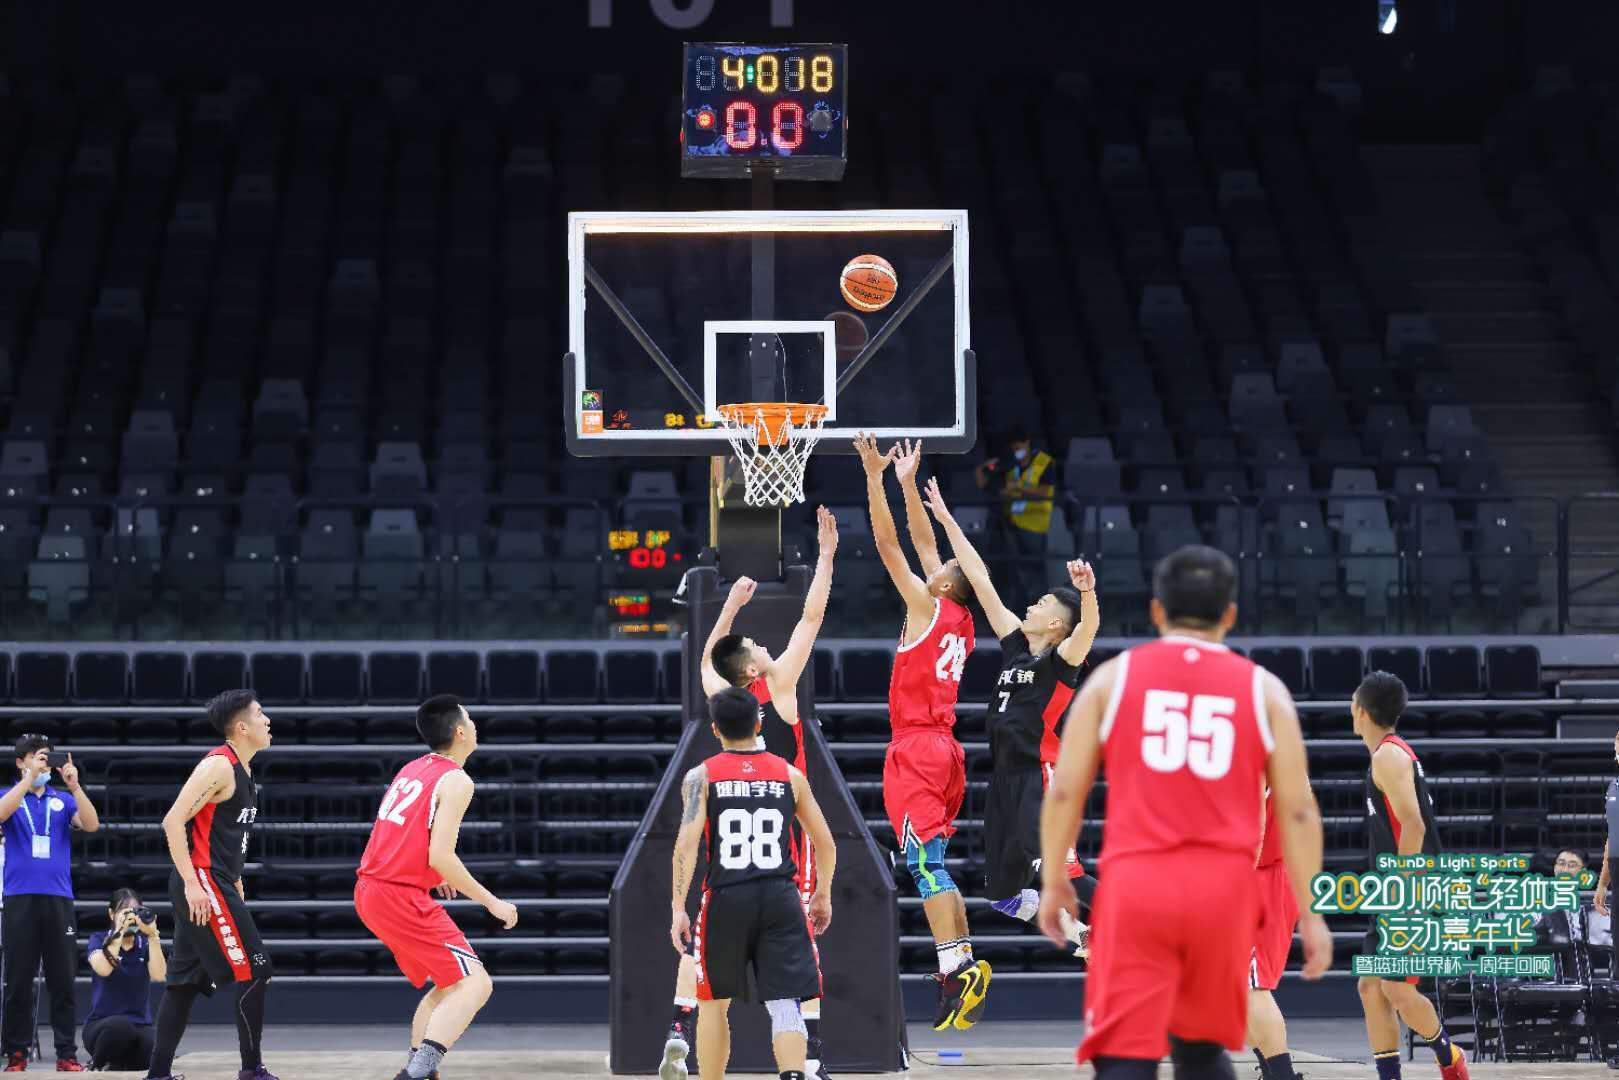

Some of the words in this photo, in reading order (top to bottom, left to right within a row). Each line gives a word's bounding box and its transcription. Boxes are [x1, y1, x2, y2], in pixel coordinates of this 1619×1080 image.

[935, 632, 966, 681] 24
[998, 690, 1011, 712] 7
[1141, 688, 1236, 780] 55
[378, 777, 424, 826] 62
[718, 807, 784, 869] 88
